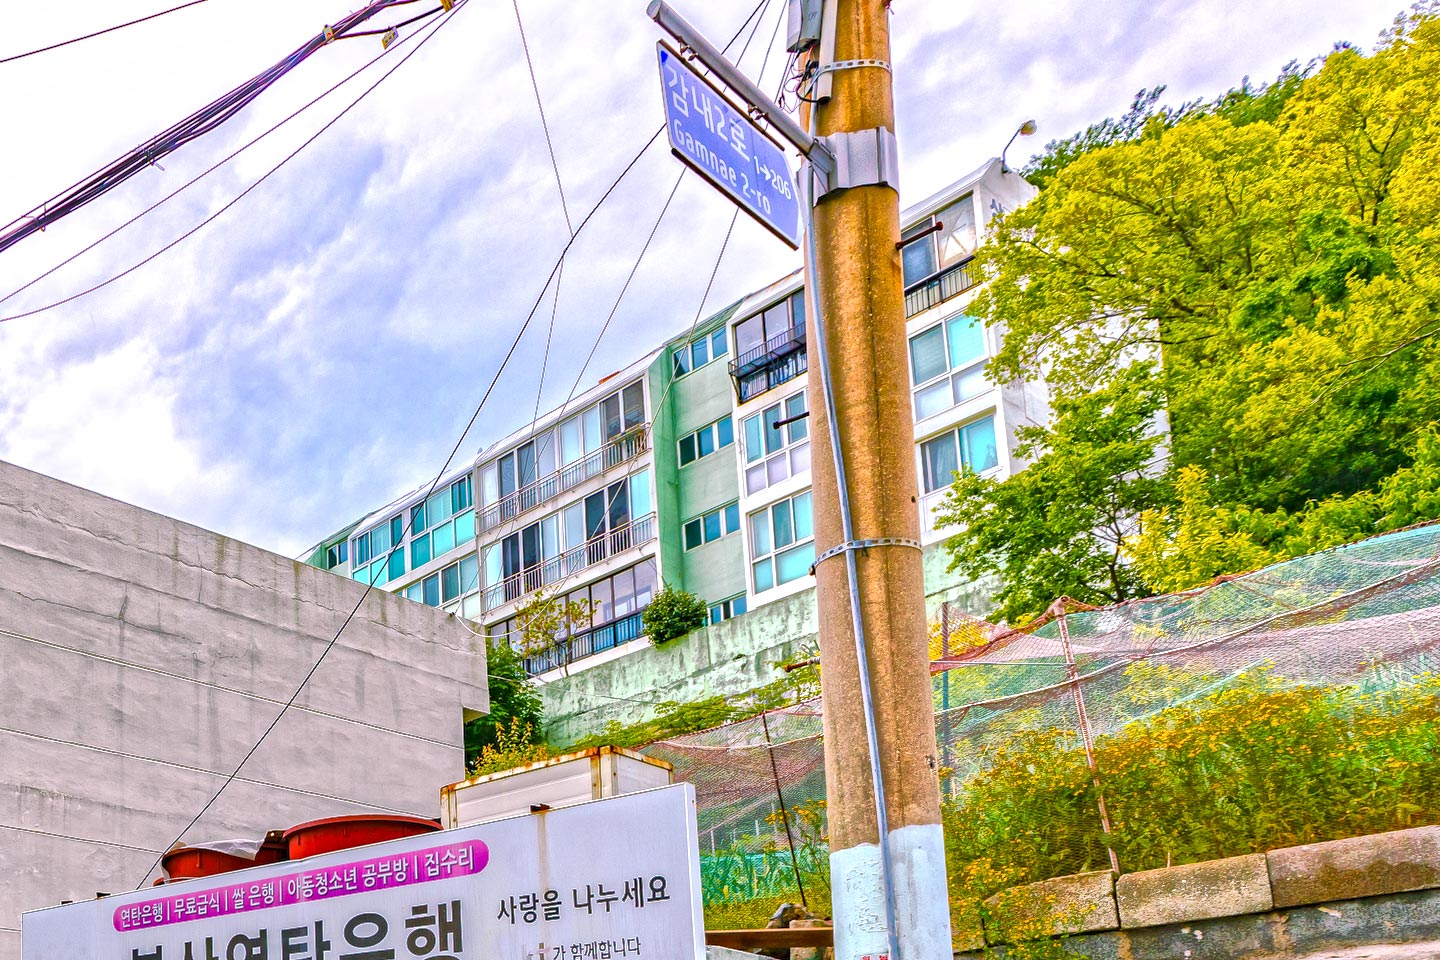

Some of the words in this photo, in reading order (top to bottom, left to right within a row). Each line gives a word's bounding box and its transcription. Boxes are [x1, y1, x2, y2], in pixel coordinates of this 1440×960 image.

[666, 64, 750, 162] 감내2로
[673, 119, 737, 187] Gamnae
[741, 173, 771, 214] 2-ro
[121, 904, 163, 928] 연탄은행
[174, 891, 220, 919] 무료급식
[232, 887, 245, 909] 쌀
[248, 881, 275, 905] 은행
[288, 866, 357, 900] 아동청소년
[362, 857, 409, 888] 공부방
[425, 845, 475, 877] 집수리
[497, 889, 562, 924] 사랑을
[572, 875, 671, 914] 나누세요
